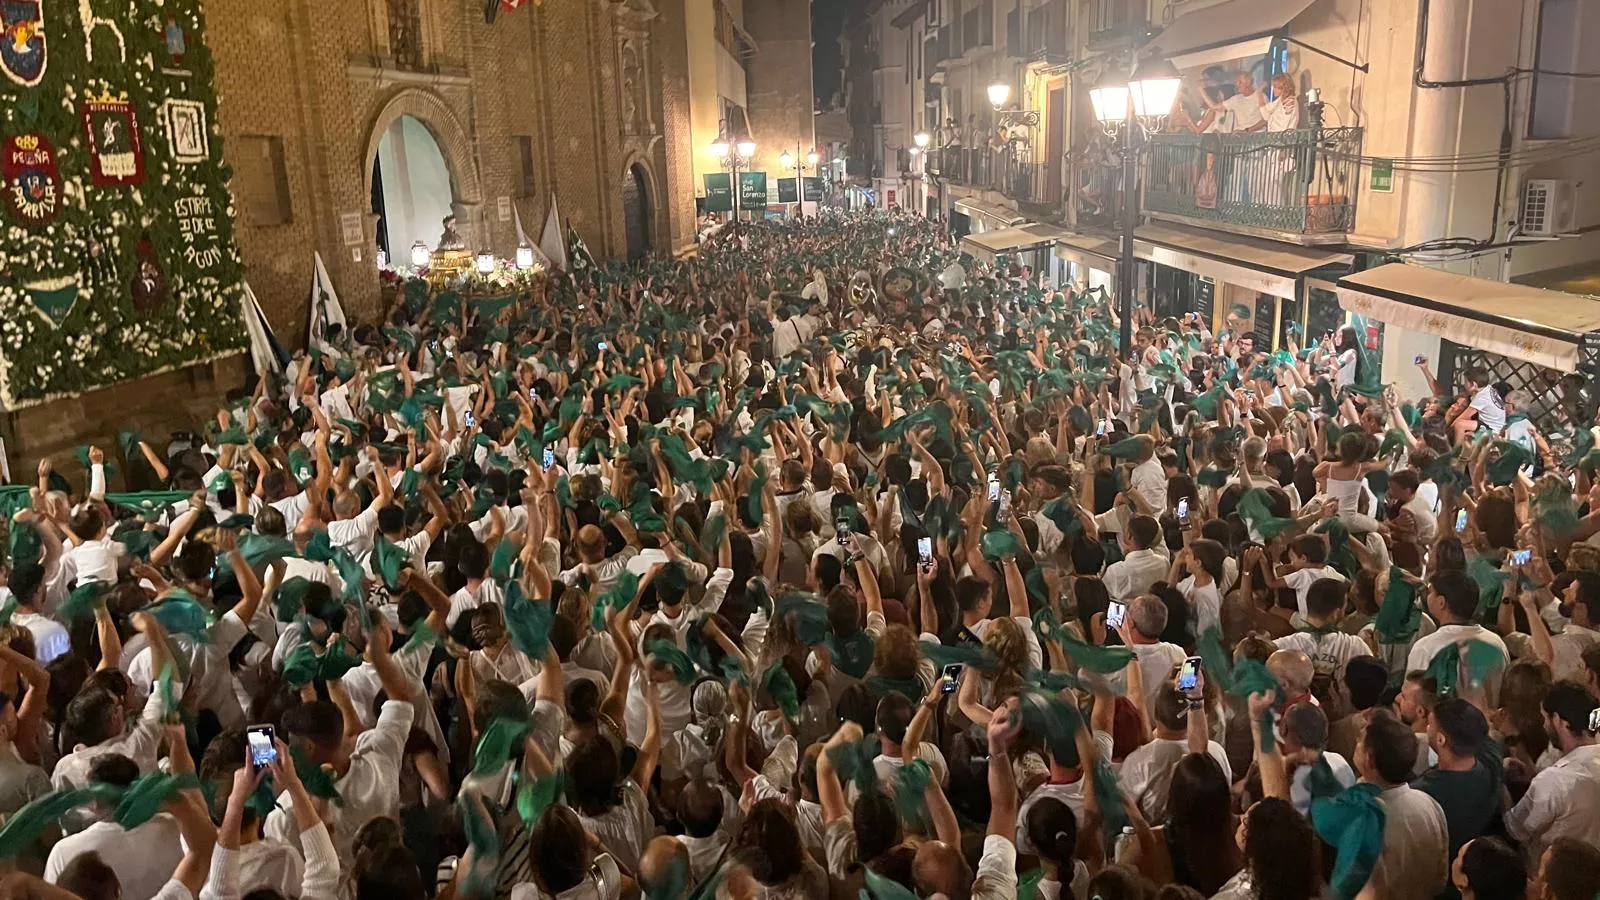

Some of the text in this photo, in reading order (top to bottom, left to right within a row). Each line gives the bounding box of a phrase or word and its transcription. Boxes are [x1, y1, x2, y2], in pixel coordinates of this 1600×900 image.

[12, 148, 50, 165] PEÑA
[742, 184, 754, 192] San
[174, 196, 213, 217] ESTIRPE
[191, 217, 205, 234] DE
